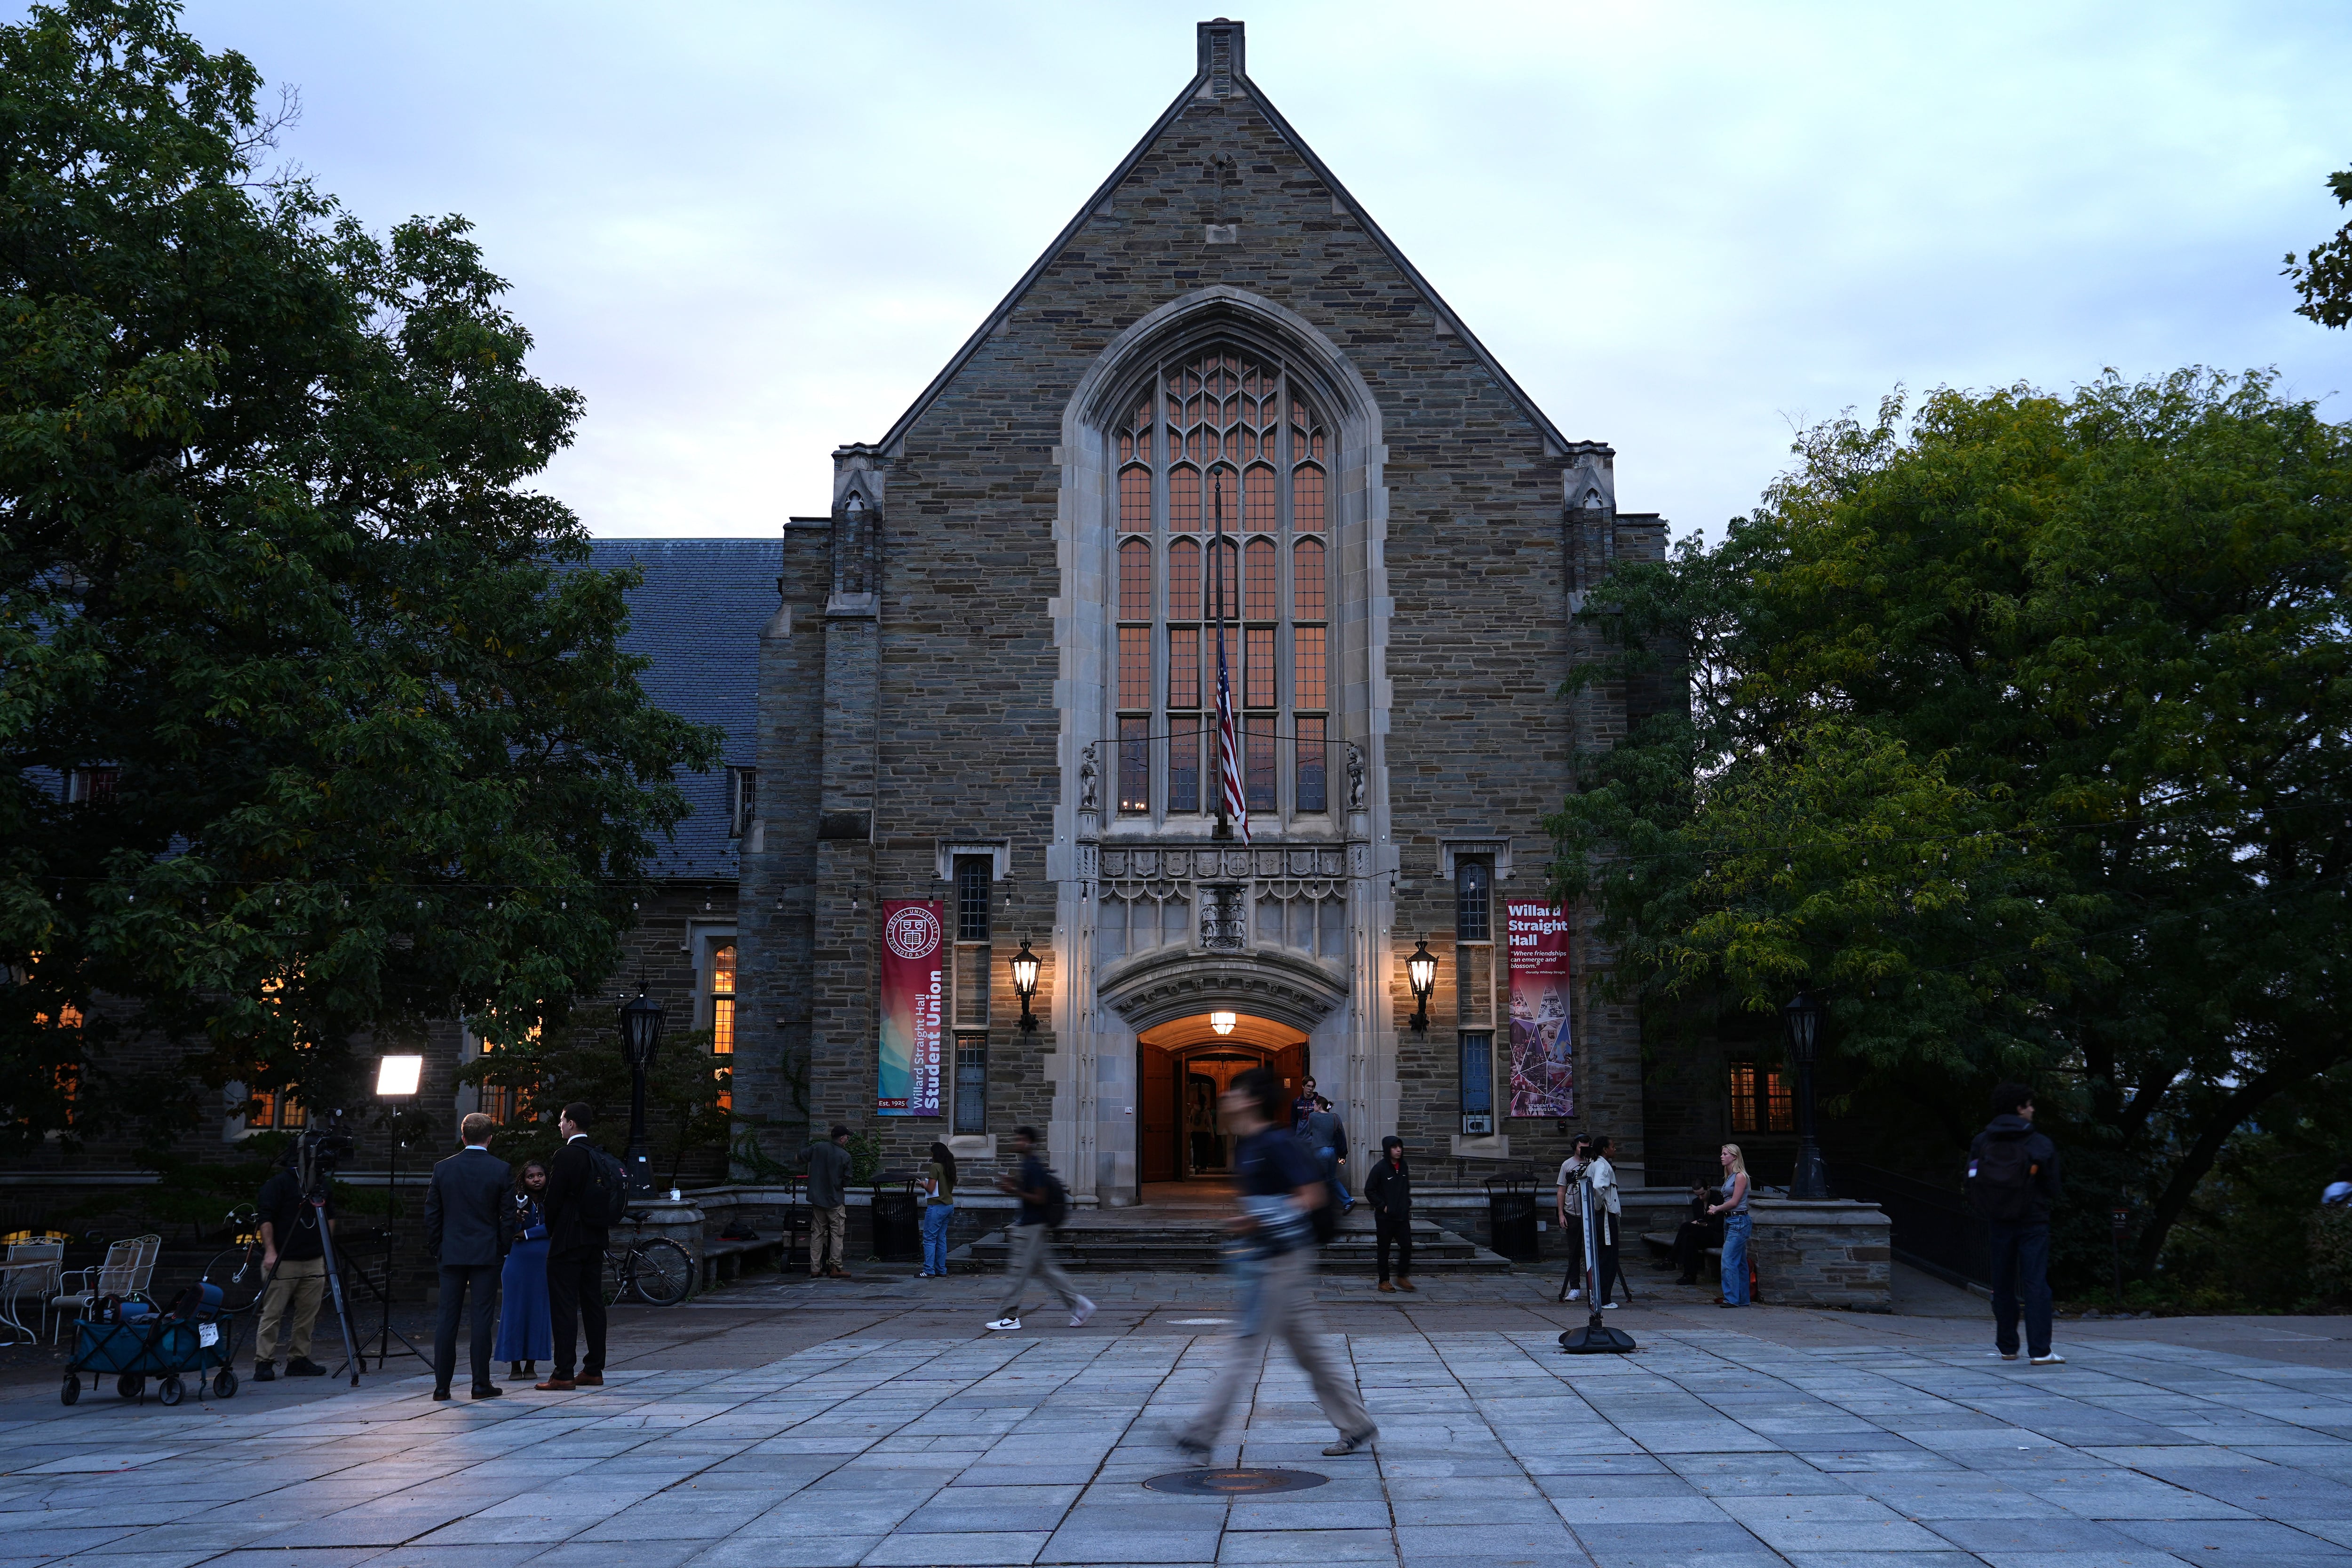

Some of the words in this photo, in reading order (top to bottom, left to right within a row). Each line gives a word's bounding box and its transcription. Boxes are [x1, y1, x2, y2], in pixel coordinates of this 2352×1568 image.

[888, 910, 907, 933] CORNELL
[909, 909, 938, 934] UNIVERSITY
[1509, 919, 1568, 935] Straight
[889, 937, 913, 957] FOUNDED
[927, 937, 937, 950] 1865
[1509, 934, 1537, 946] Hall
[915, 994, 925, 1015] Hall
[925, 971, 942, 1026] Union
[914, 1019, 928, 1064] Straight
[924, 1032, 941, 1109] Student
[913, 1068, 923, 1109] Willard
